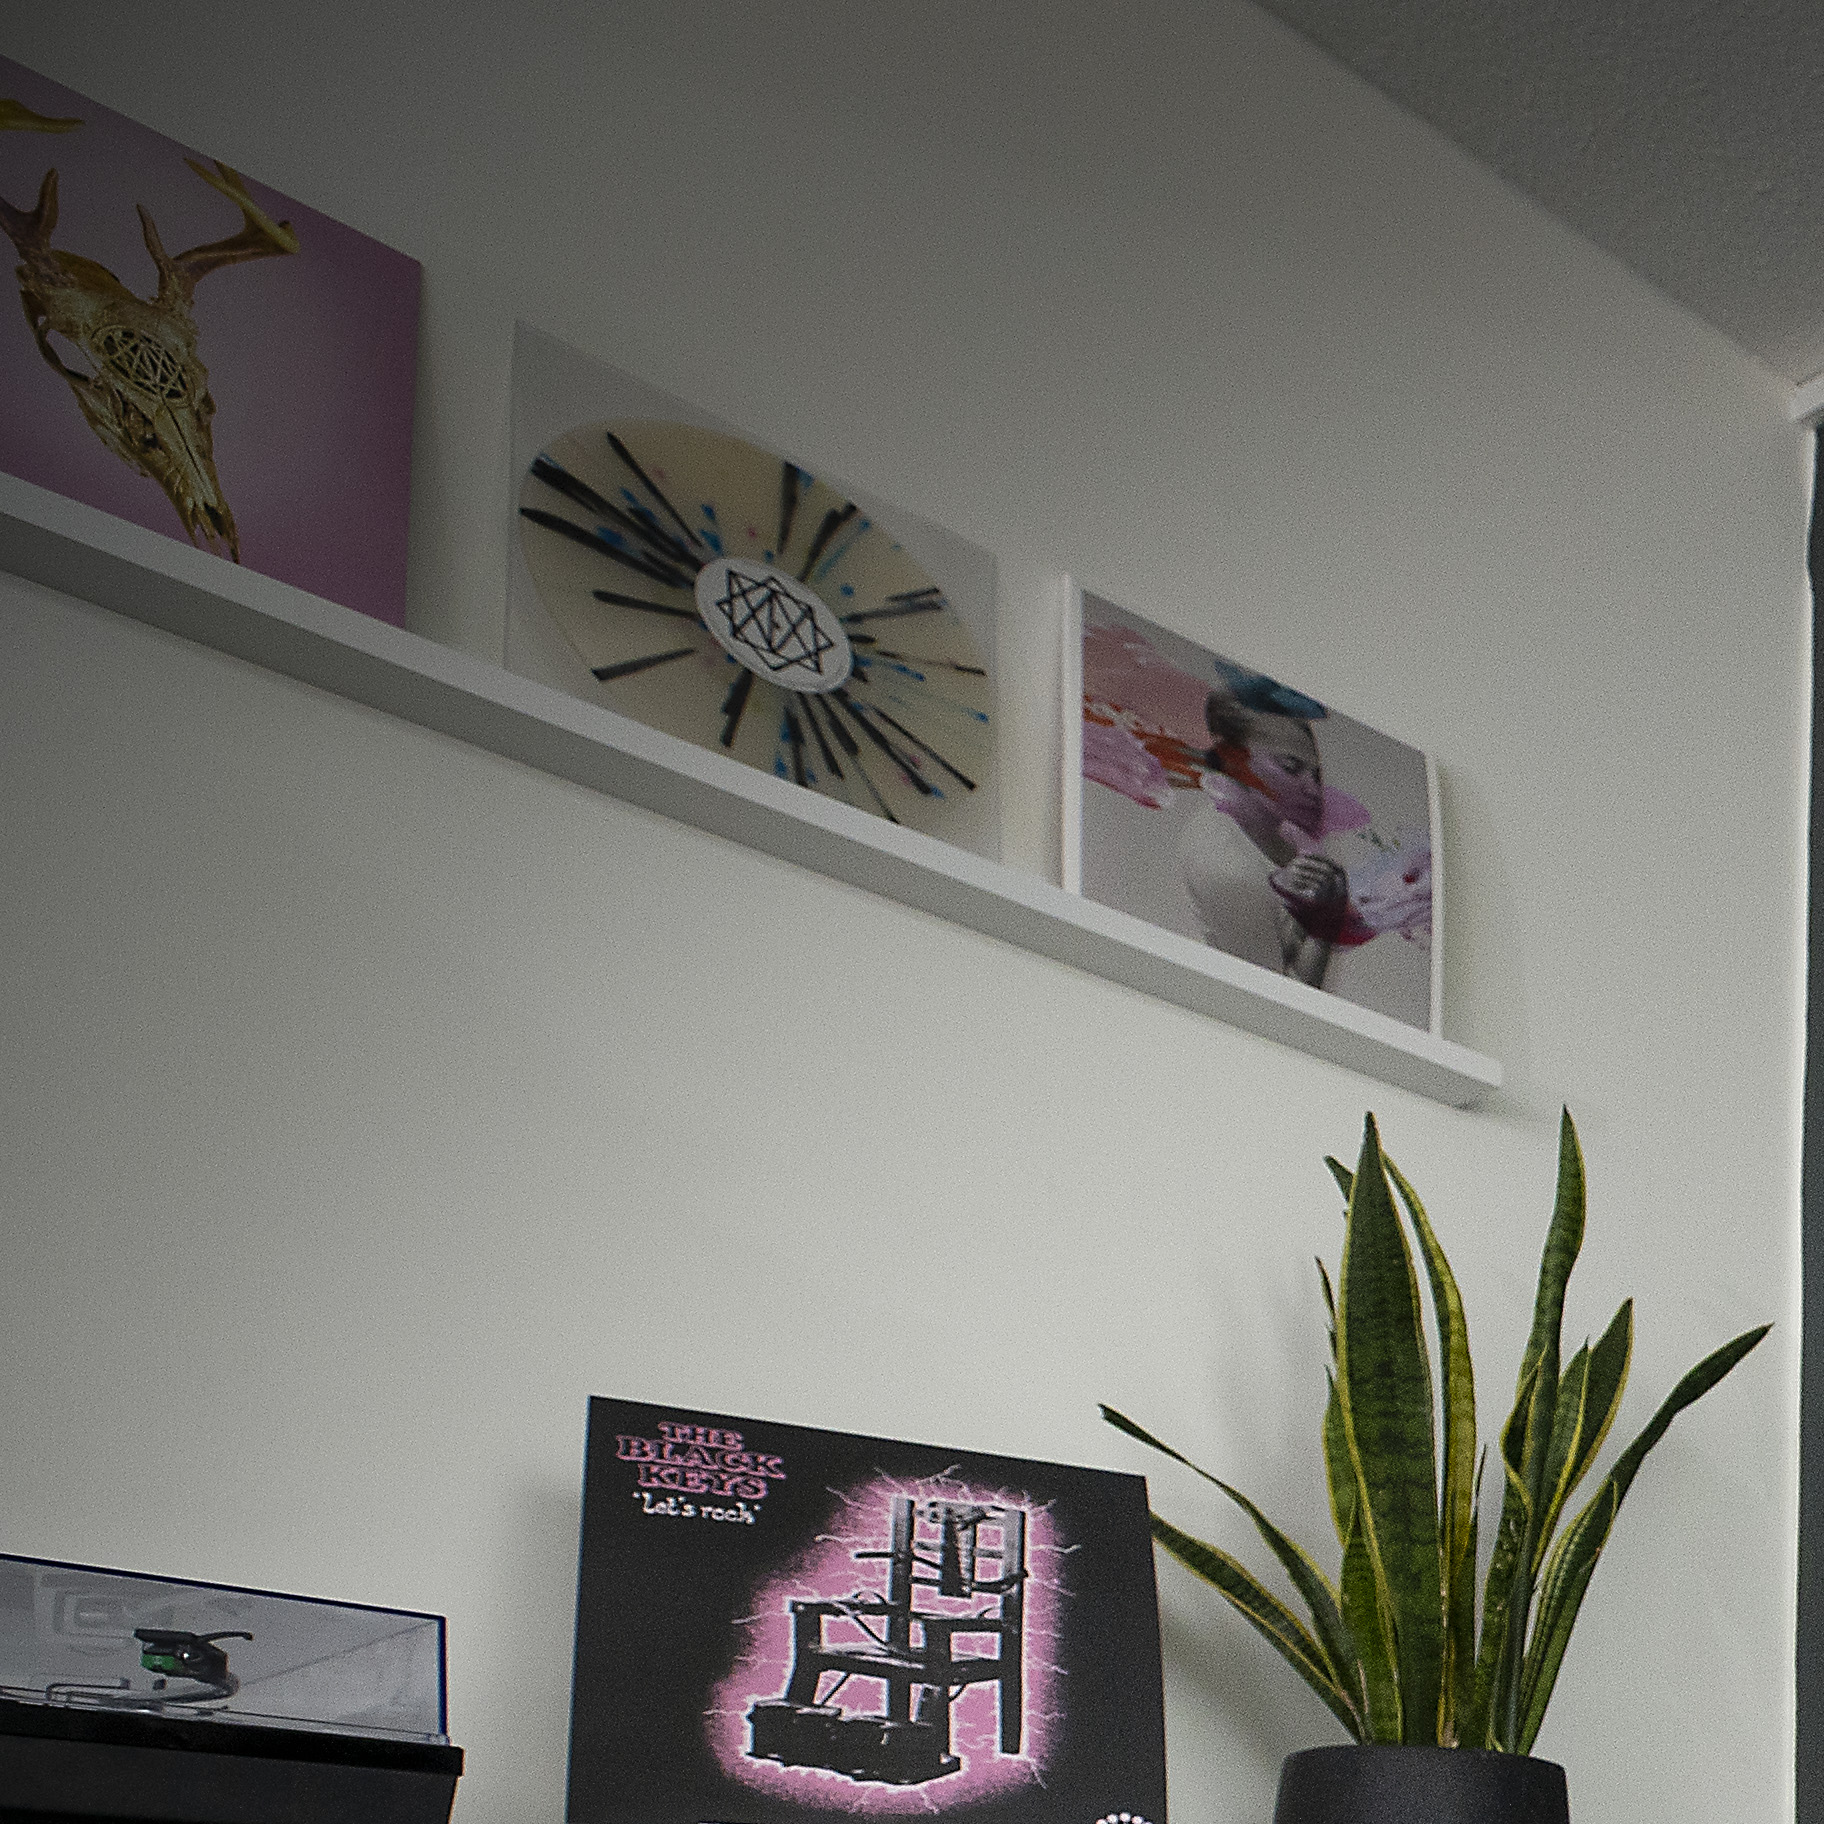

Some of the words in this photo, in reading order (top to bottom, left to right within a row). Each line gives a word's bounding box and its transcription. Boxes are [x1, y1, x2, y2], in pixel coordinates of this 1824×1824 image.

[657, 1421, 745, 1451] THE
[616, 1434, 786, 1479] BLACK
[638, 1463, 768, 1500] KEYS
